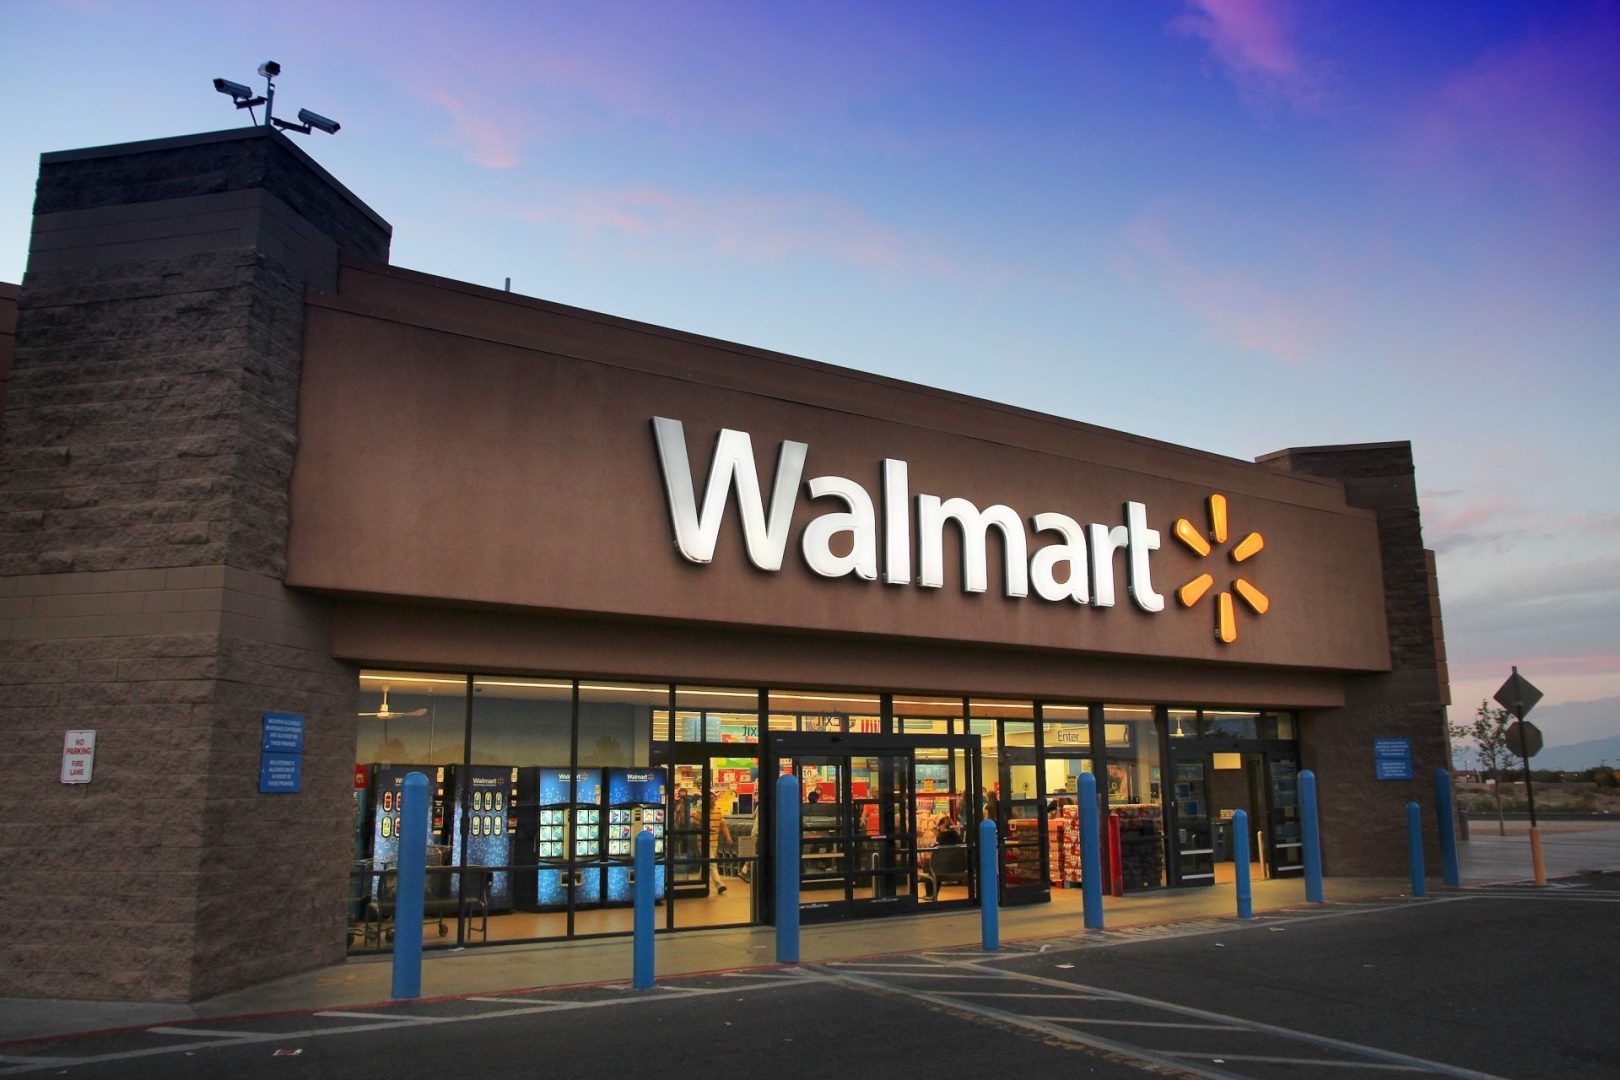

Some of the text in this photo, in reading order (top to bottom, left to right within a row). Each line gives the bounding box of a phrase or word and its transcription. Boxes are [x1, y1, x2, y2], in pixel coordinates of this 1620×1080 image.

[650, 415, 1164, 612] Walmart
[1057, 730, 1080, 742] Enter
[75, 738, 84, 746] NO
[558, 773, 581, 781] Walrt
